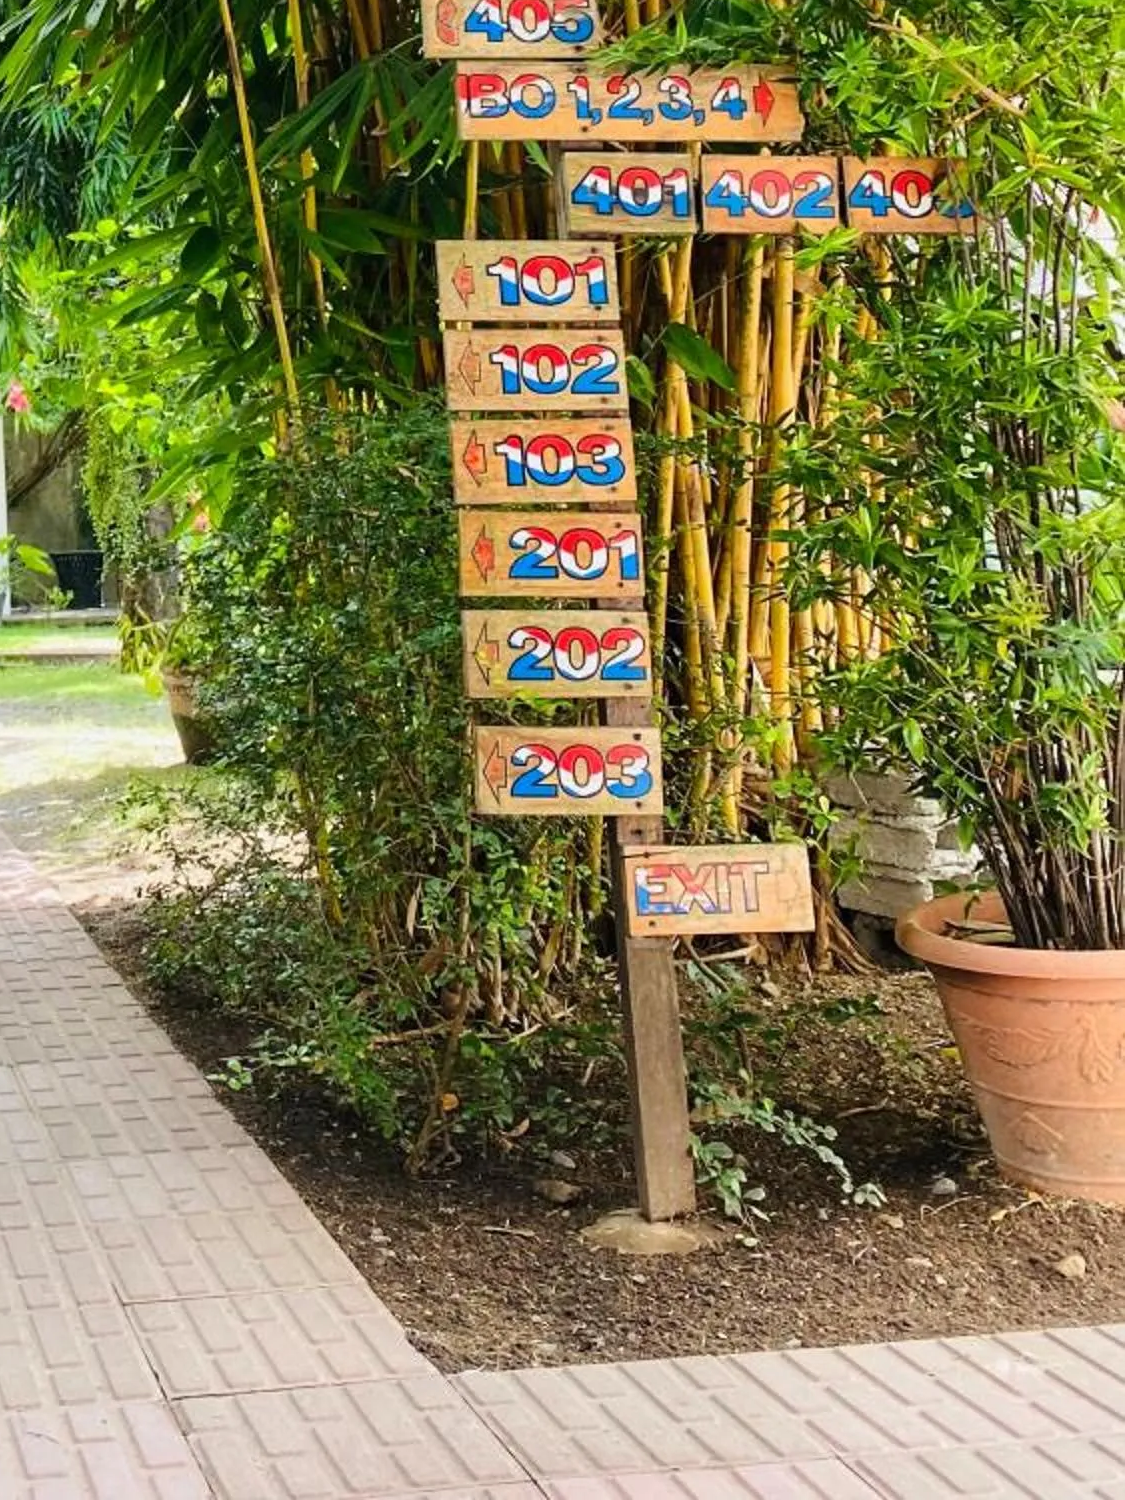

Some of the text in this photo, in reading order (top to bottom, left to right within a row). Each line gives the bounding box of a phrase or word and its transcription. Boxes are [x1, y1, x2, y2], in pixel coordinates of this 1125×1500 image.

[456, 73, 556, 118] BO
[571, 165, 690, 217] 401
[706, 169, 835, 218] 402
[848, 169, 975, 218] 40
[487, 256, 608, 305] 101
[491, 344, 619, 394] 102
[496, 434, 625, 486] 103
[509, 527, 639, 580] 201
[507, 626, 647, 681] 202
[510, 743, 653, 799] 203
[635, 861, 769, 916] EXIT
